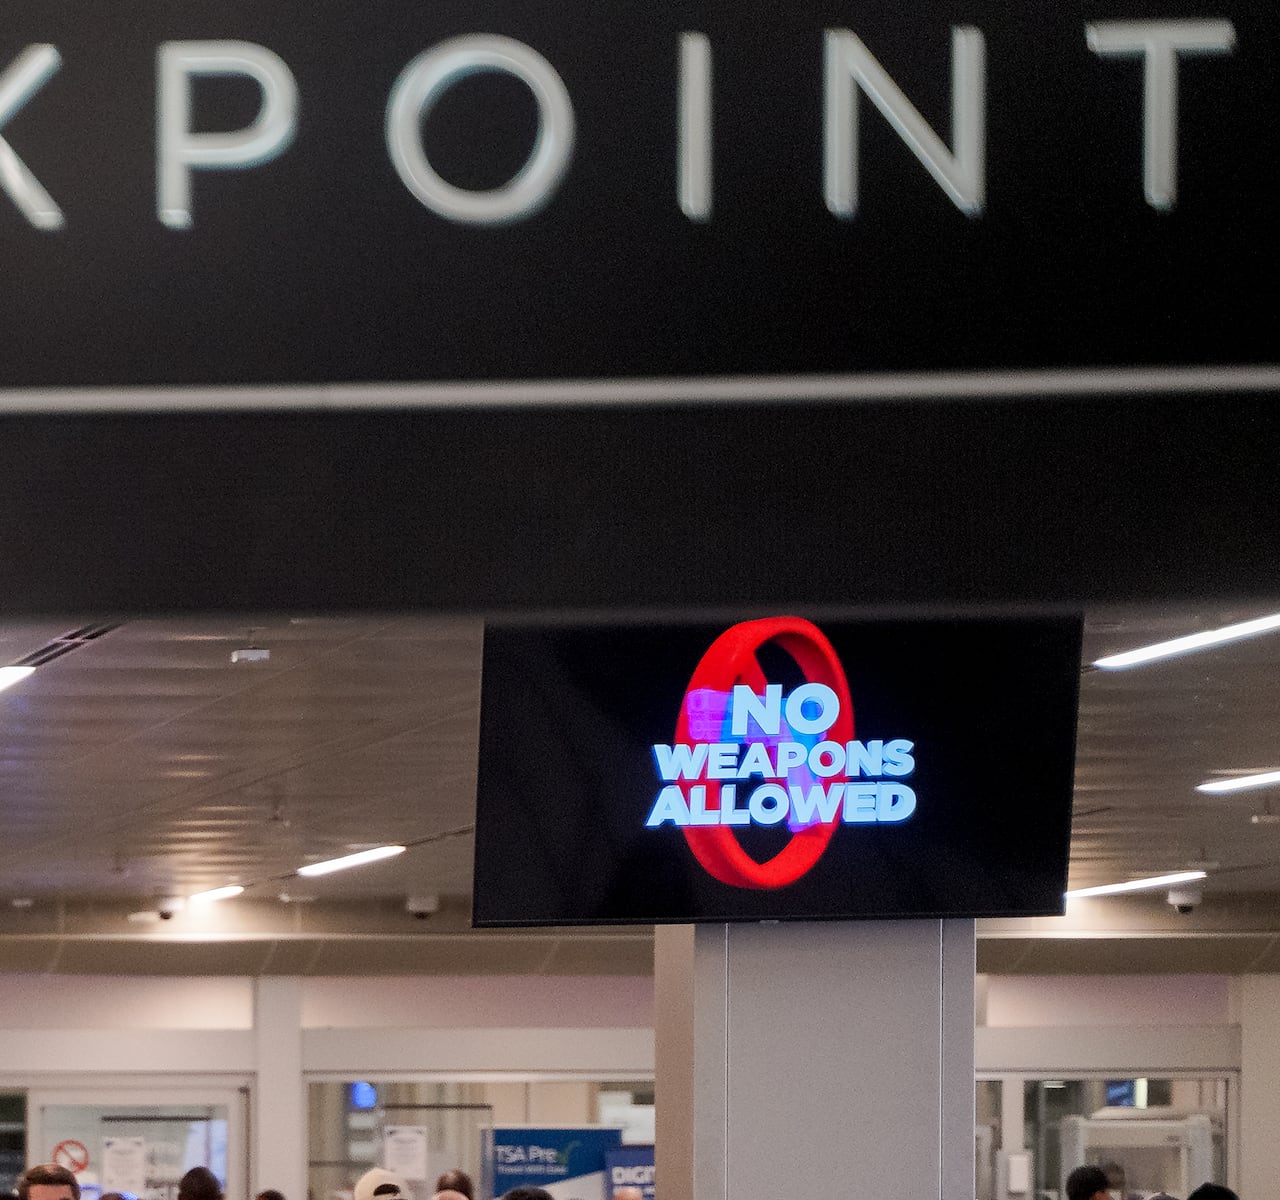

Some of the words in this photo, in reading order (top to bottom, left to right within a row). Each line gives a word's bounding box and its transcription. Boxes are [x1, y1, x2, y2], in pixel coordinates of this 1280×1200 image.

[731, 682, 840, 735] NO
[652, 739, 915, 781] WEAPONS
[645, 782, 916, 827] ALLOWED
[495, 1145, 525, 1163] TSA
